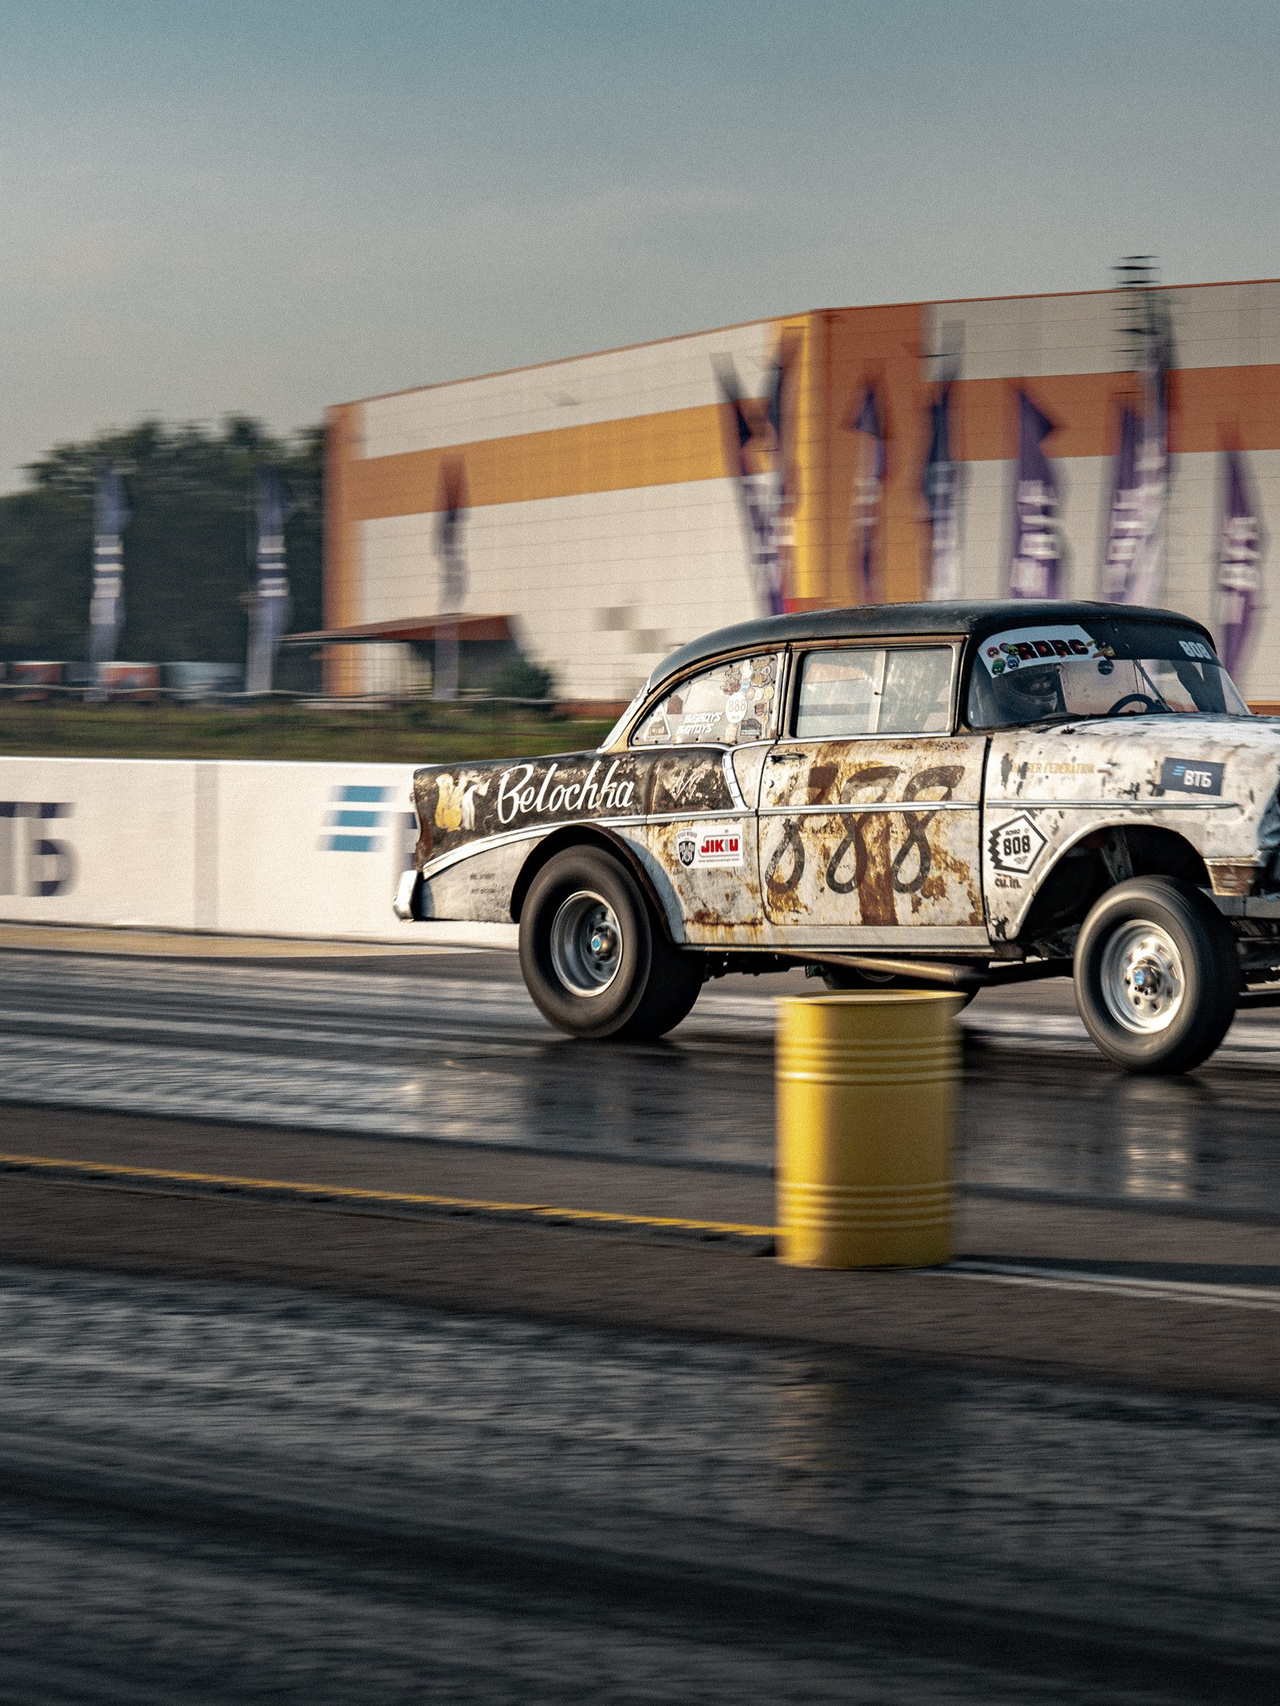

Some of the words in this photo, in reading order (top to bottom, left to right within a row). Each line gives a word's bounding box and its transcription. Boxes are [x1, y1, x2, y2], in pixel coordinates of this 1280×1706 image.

[1178, 640, 1212, 660] 808
[728, 699, 746, 712] 888
[1183, 769, 1213, 788] ВТБ
[497, 759, 635, 824] Belochka
[765, 763, 965, 894] 888
[701, 838, 739, 853] JIKIU
[1003, 834, 1031, 856] 808
